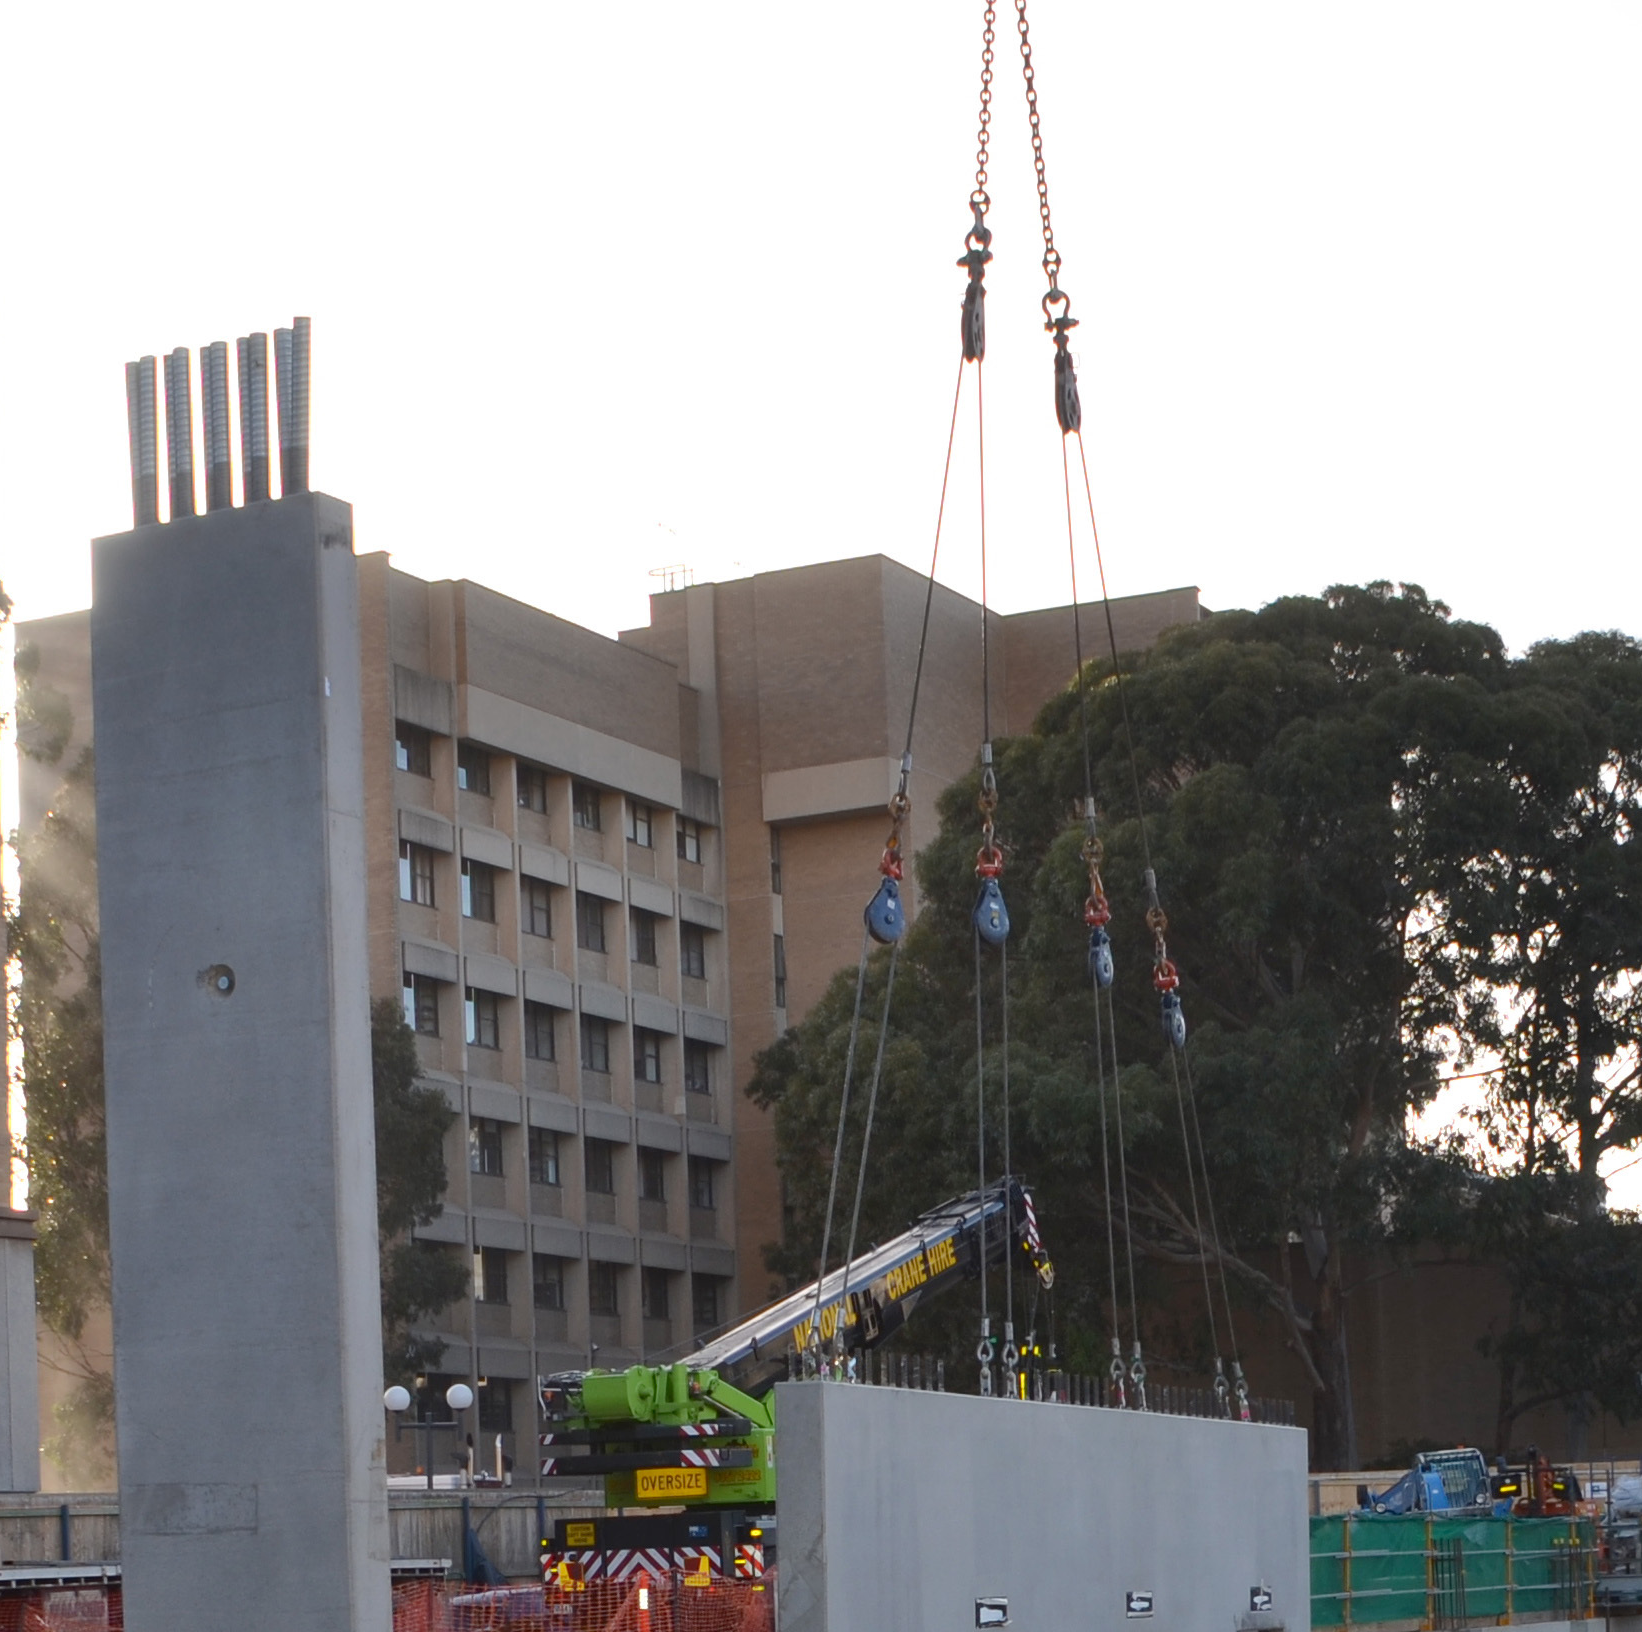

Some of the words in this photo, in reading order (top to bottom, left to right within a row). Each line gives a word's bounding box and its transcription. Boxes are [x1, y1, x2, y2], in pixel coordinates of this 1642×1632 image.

[886, 1254, 927, 1300] CRANE
[926, 1236, 957, 1277] HIRE
[641, 1473, 702, 1491] OVERSIZE
